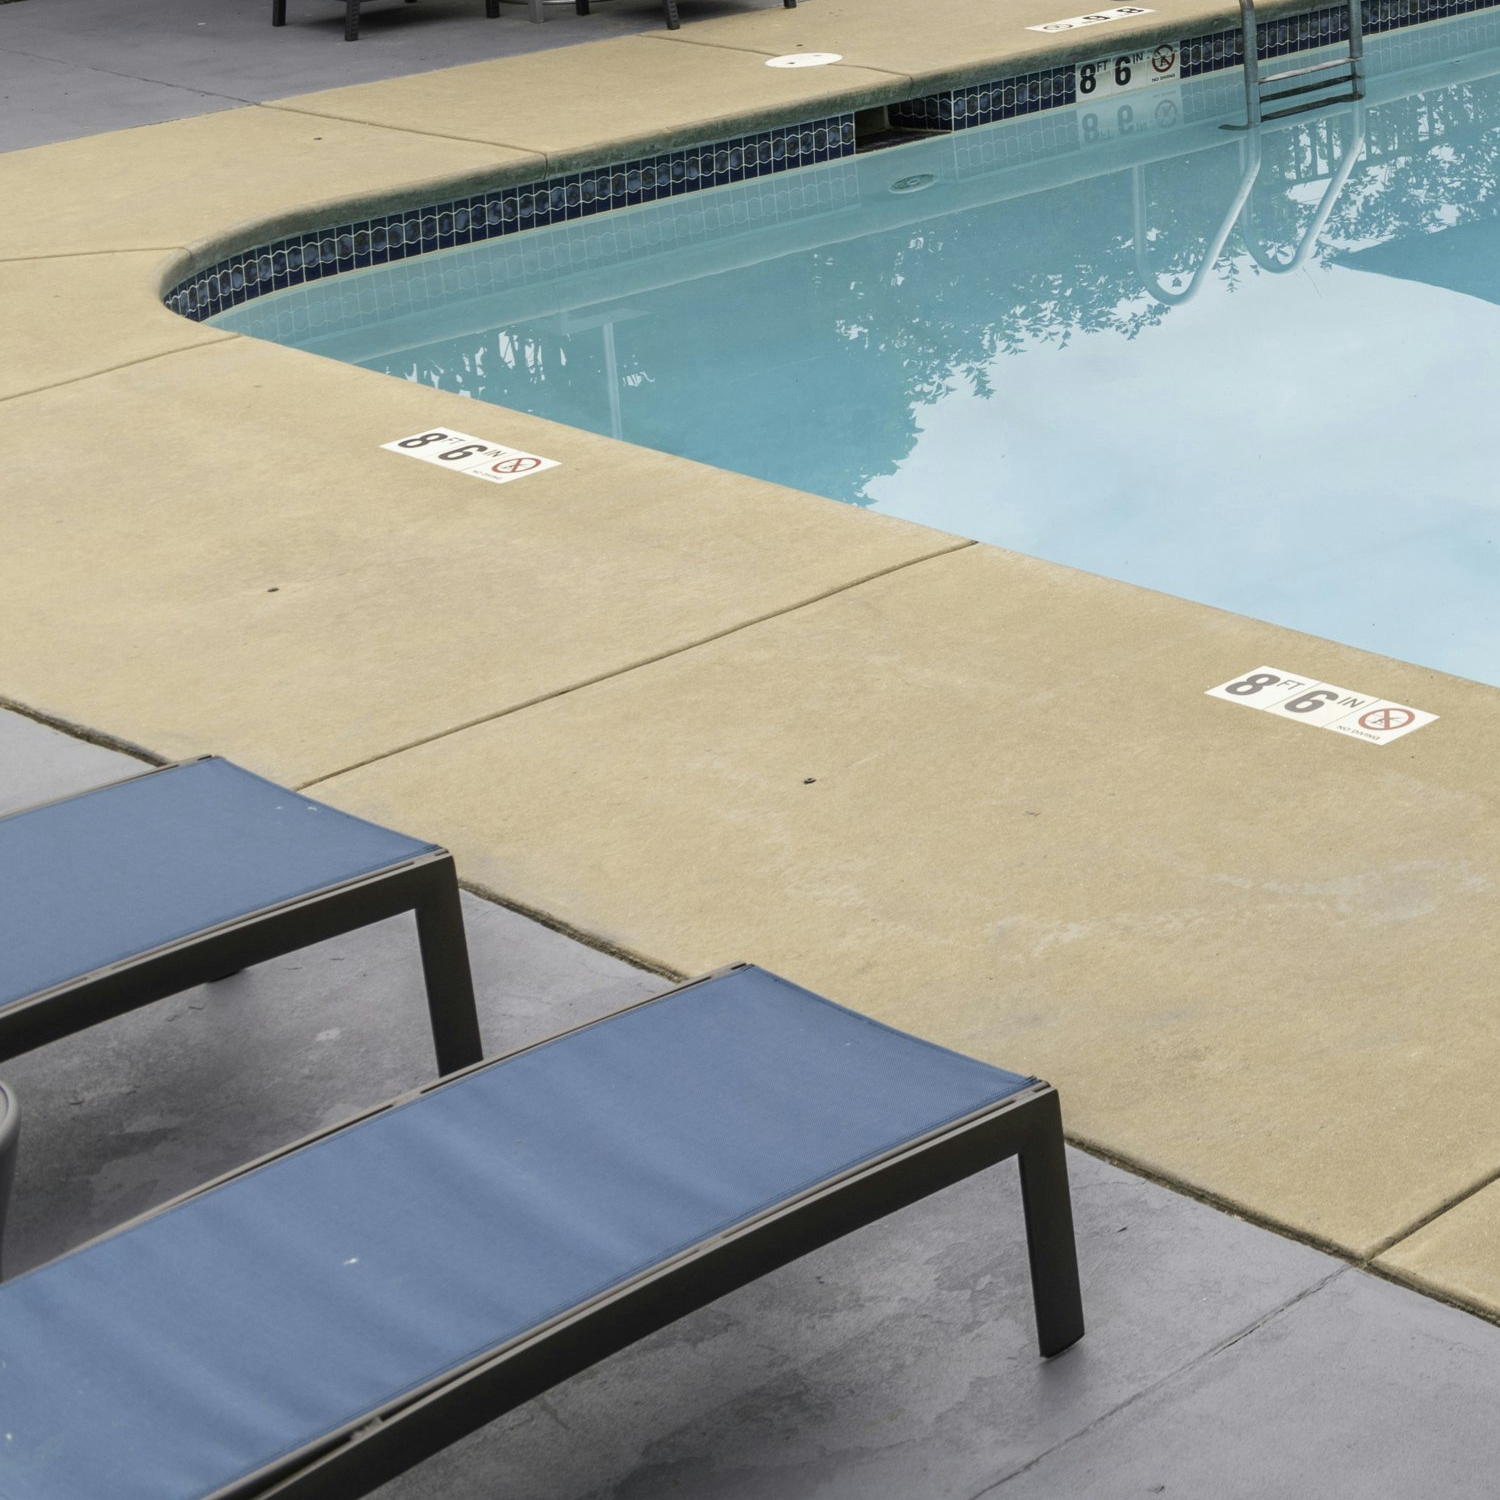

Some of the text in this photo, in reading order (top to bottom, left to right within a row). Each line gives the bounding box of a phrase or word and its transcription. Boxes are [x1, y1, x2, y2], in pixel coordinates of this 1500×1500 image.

[1079, 53, 1144, 94] 8 FT 6 IN
[397, 432, 504, 461] 8 FT 6 IN
[1225, 673, 1366, 713] 8 FT 6 IN
[1336, 724, 1381, 741] NO DIVING
